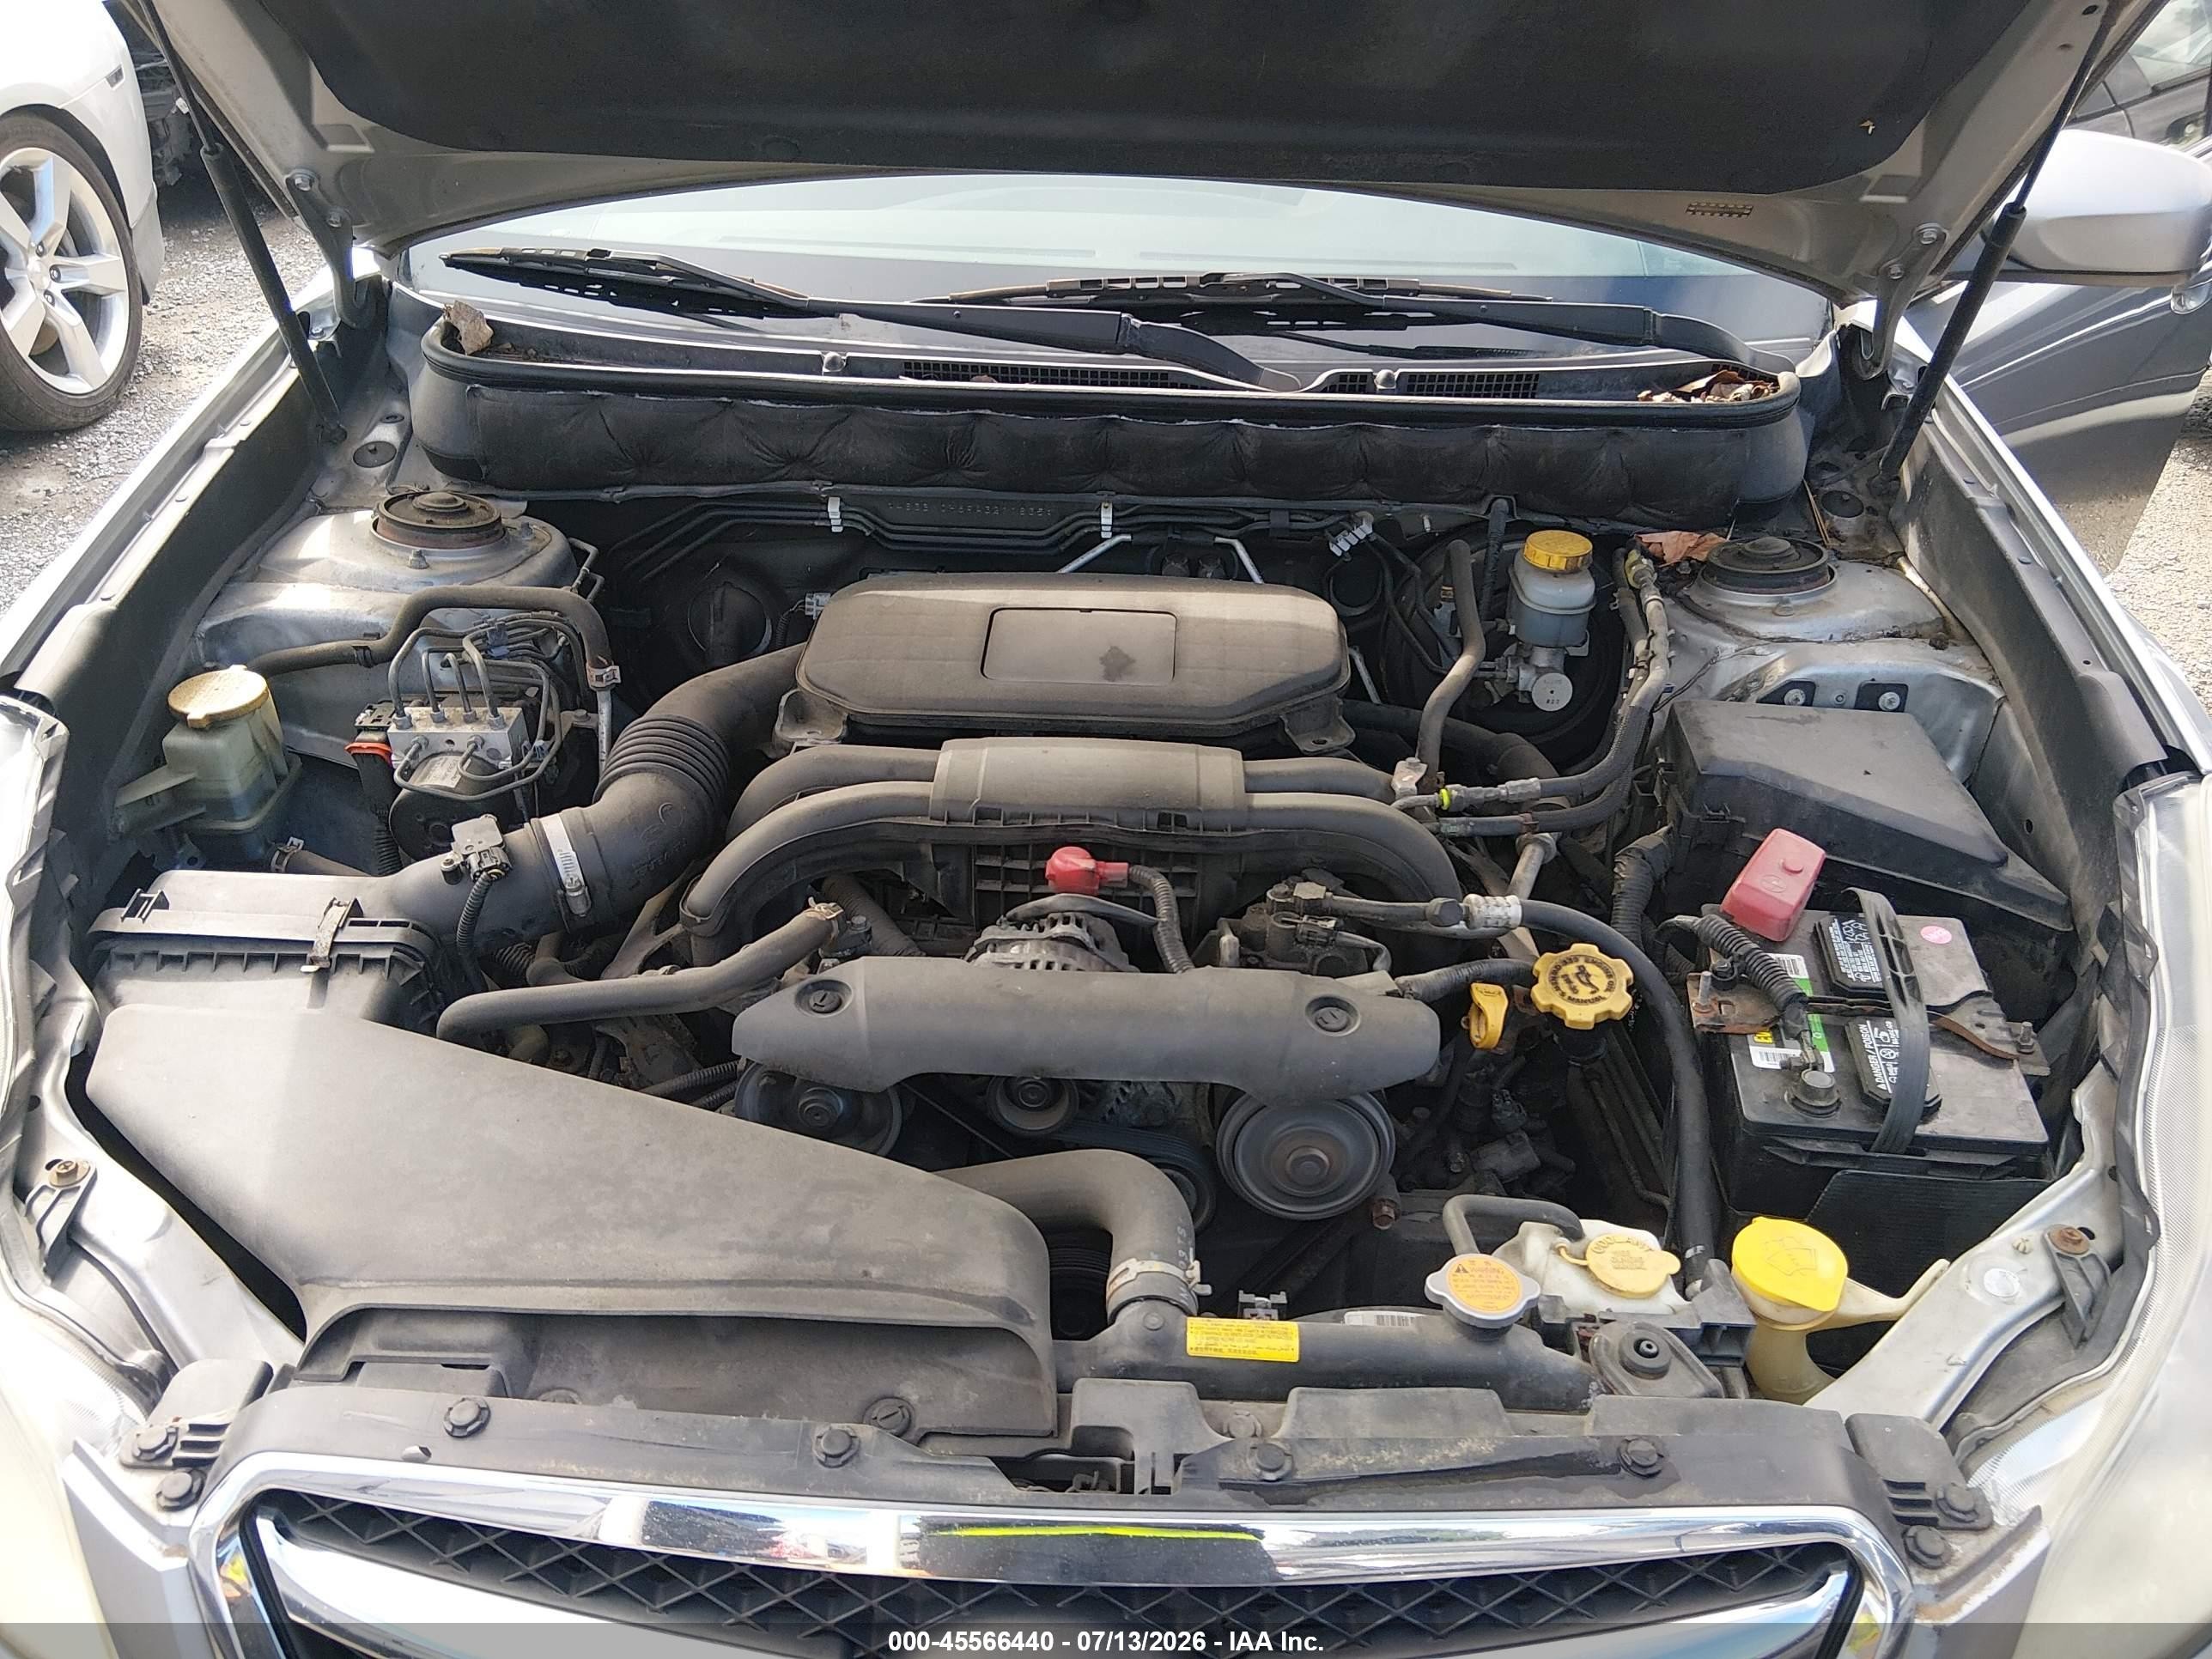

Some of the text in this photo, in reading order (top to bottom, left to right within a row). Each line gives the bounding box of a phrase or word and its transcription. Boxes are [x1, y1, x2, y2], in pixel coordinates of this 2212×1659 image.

[1567, 995, 1607, 1004] MANUAL
[1857, 1024, 1874, 1049] POISON
[1868, 1054, 1885, 1083] DANGER
